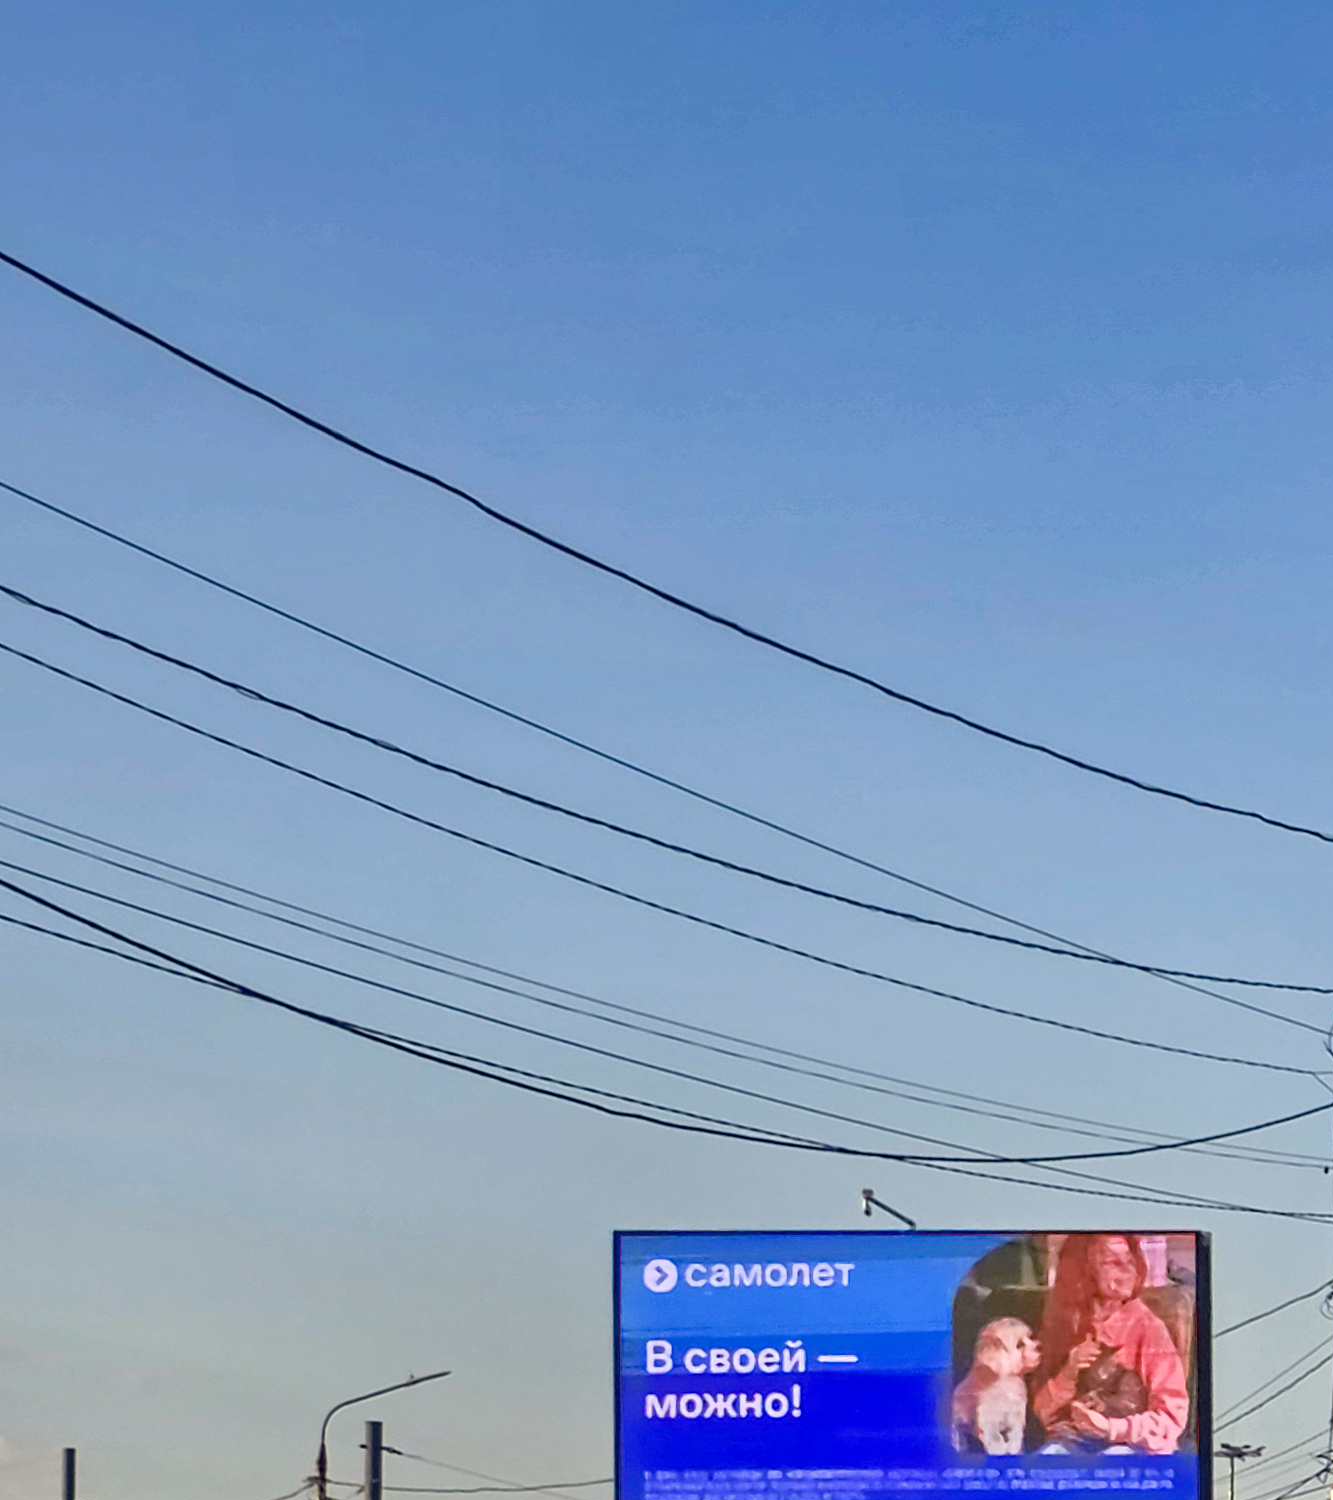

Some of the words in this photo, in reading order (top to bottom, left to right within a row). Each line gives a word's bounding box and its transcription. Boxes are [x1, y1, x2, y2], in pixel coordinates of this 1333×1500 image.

[685, 1262, 855, 1287] самолет
[646, 1339, 673, 1374] В
[684, 1339, 806, 1374] своей
[645, 1383, 801, 1419] можно!
